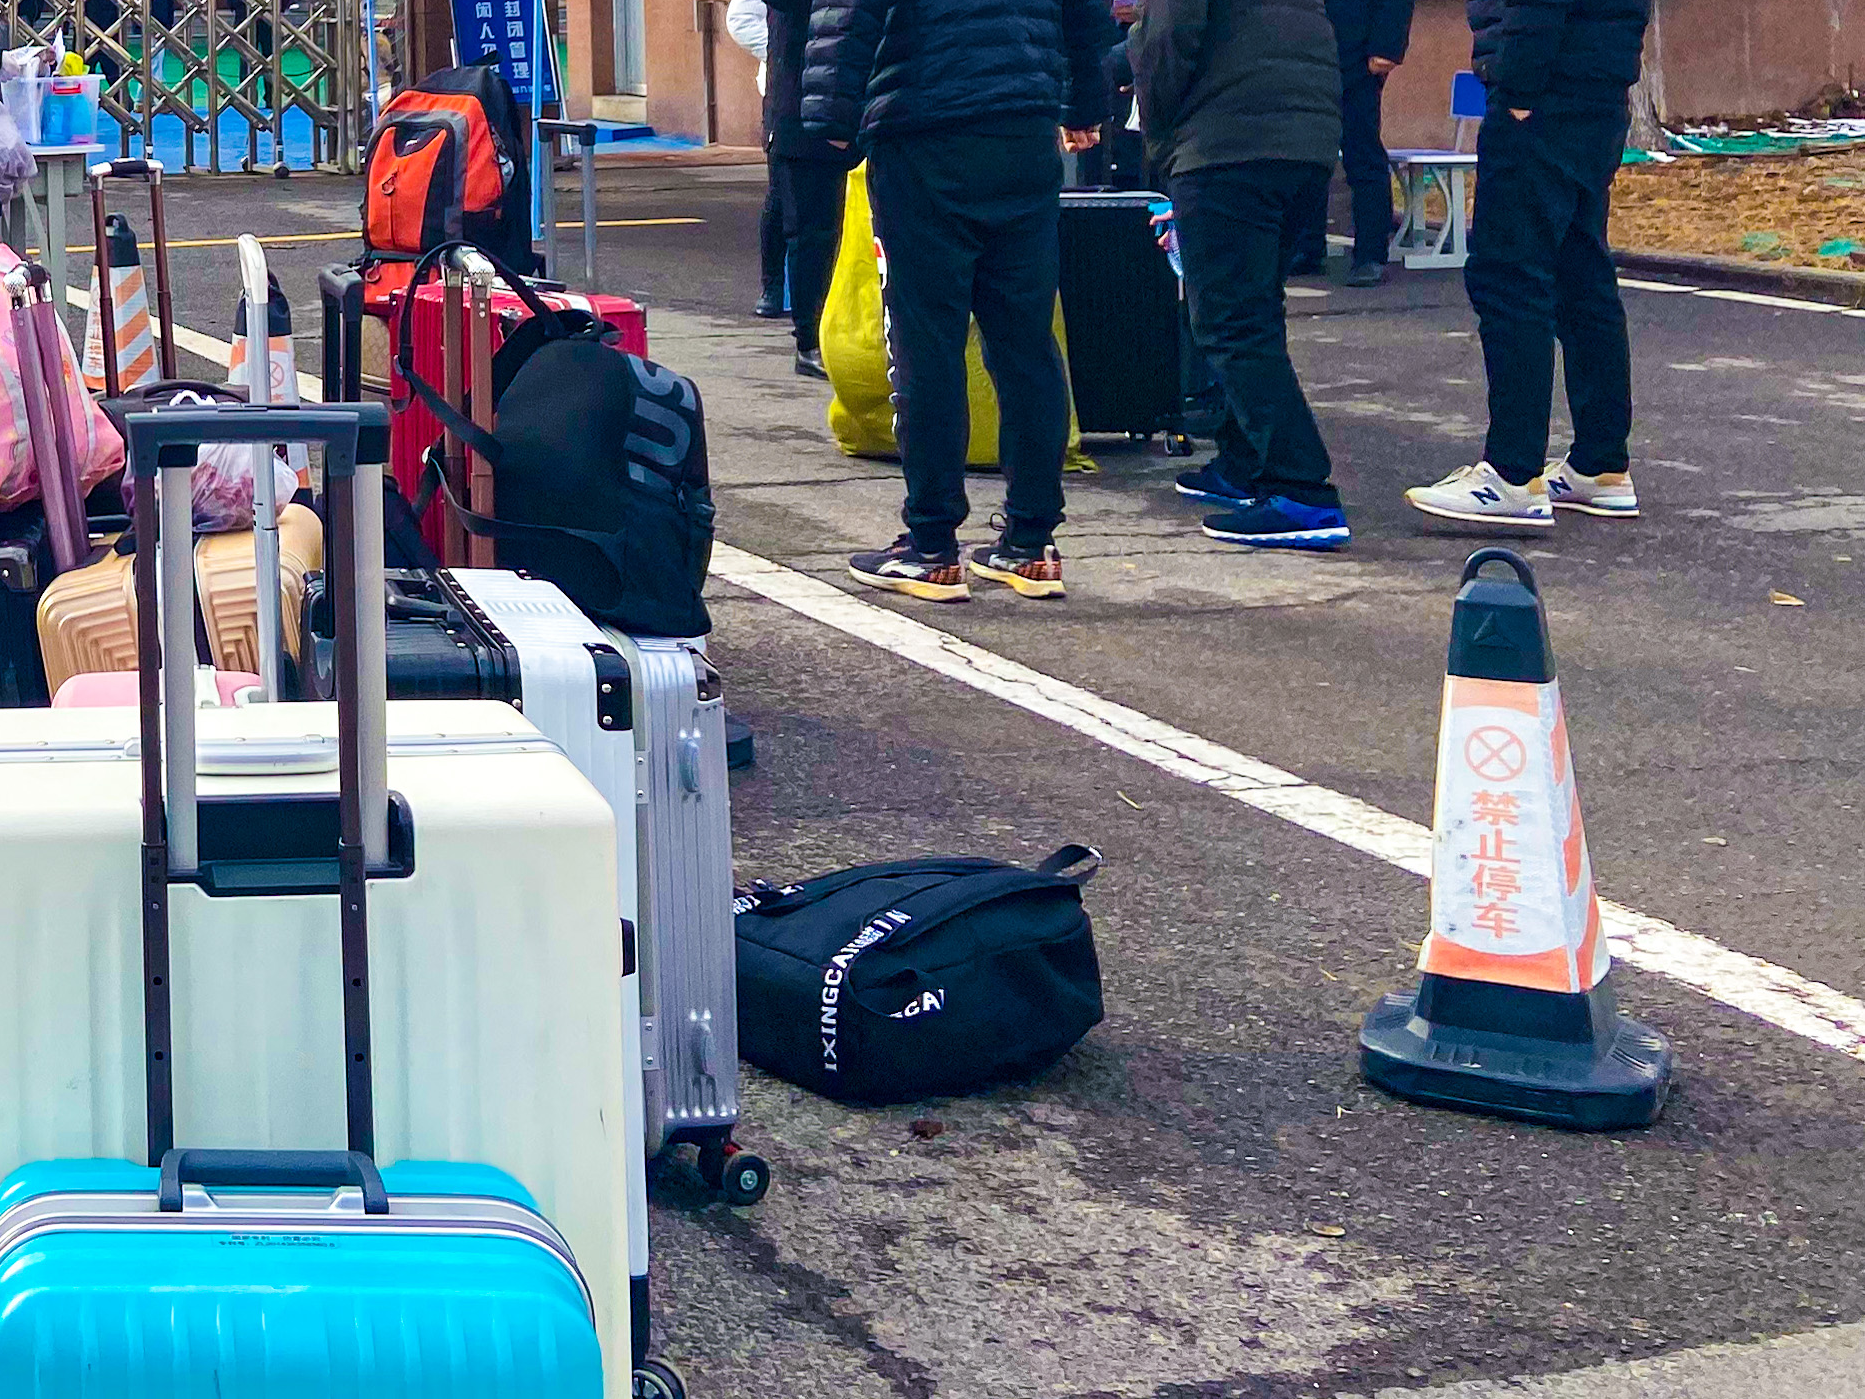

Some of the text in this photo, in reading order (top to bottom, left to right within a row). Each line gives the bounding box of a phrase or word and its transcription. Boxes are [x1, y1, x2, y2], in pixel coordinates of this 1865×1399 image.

[503, 0, 531, 79] 封闭管理
[1470, 789, 1522, 940] 禁止停车
